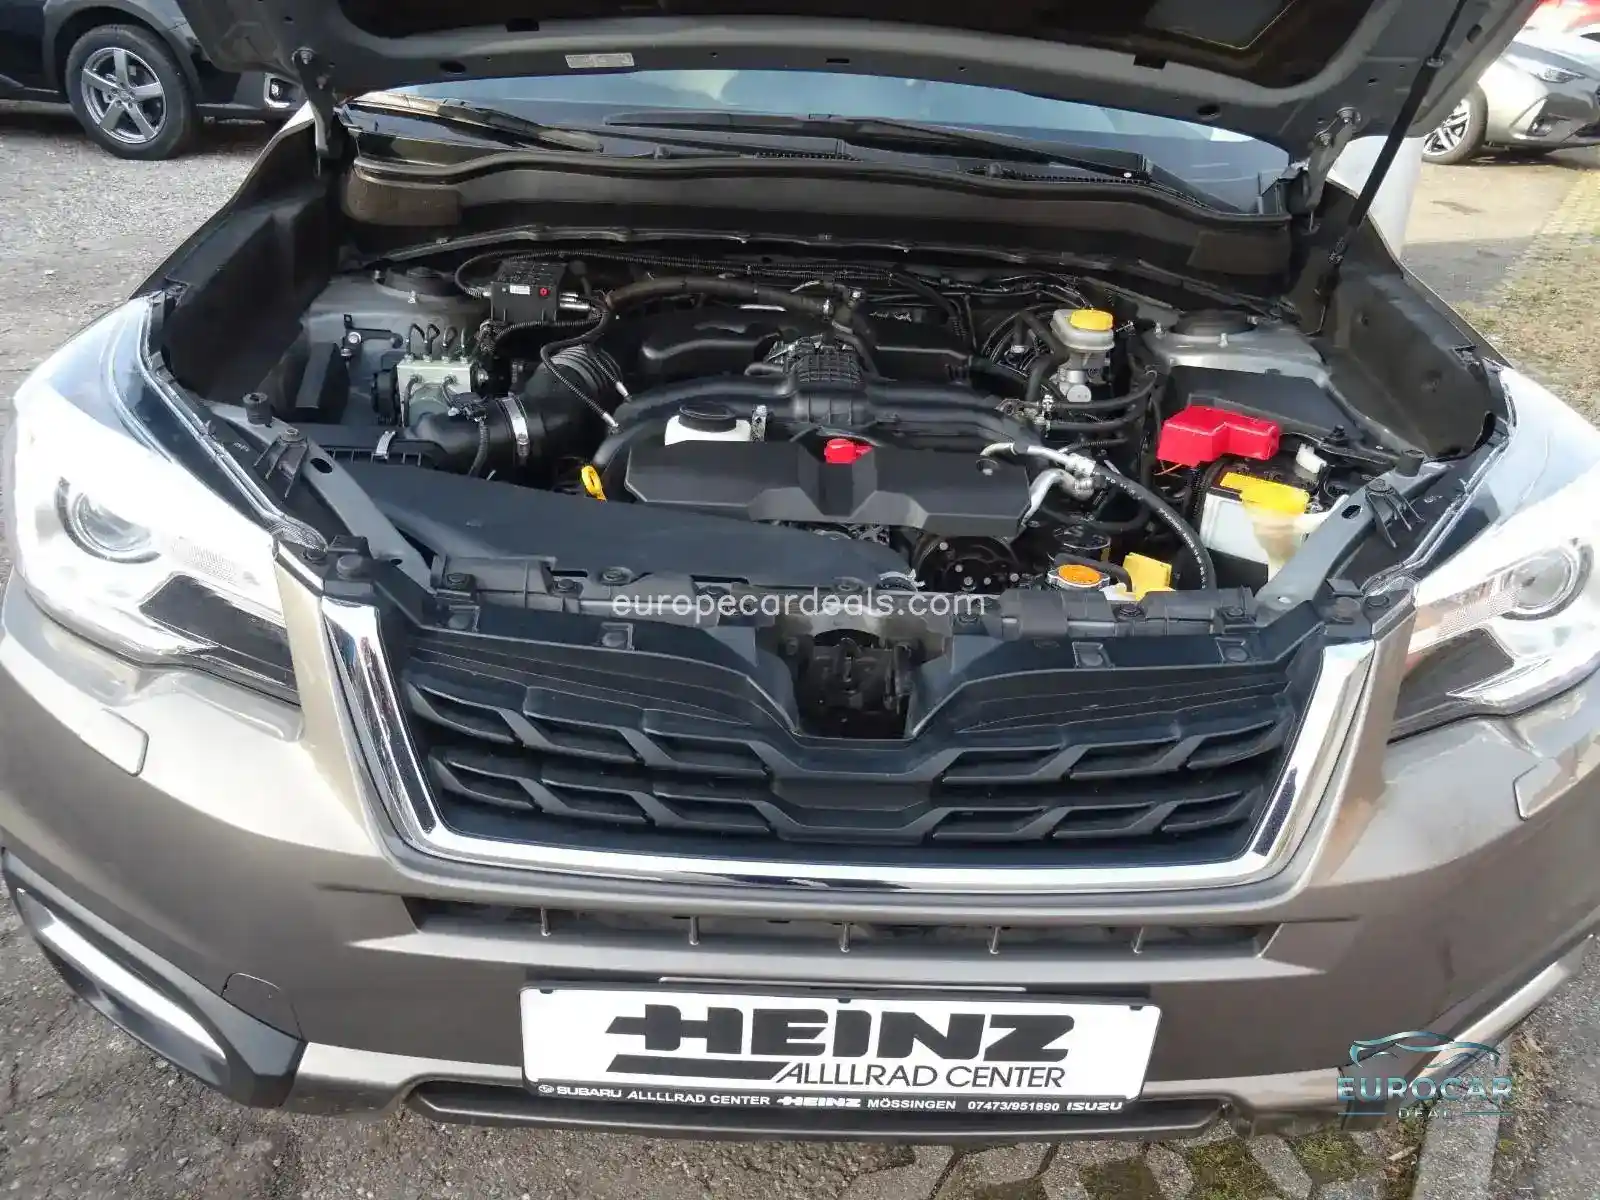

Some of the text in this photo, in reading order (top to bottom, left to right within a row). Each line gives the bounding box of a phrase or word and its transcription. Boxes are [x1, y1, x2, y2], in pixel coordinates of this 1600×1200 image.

[605, 1003, 1075, 1063] HEINZ
[775, 1062, 1065, 1089] ALLLLRAD CENTER
[556, 1085, 622, 1098] SUBARU
[627, 1090, 706, 1104] ALLLLRAD
[709, 1094, 770, 1106] CENTER
[867, 1097, 956, 1111] MÖSSINGEN
[1066, 1101, 1123, 1112] ISUZU
